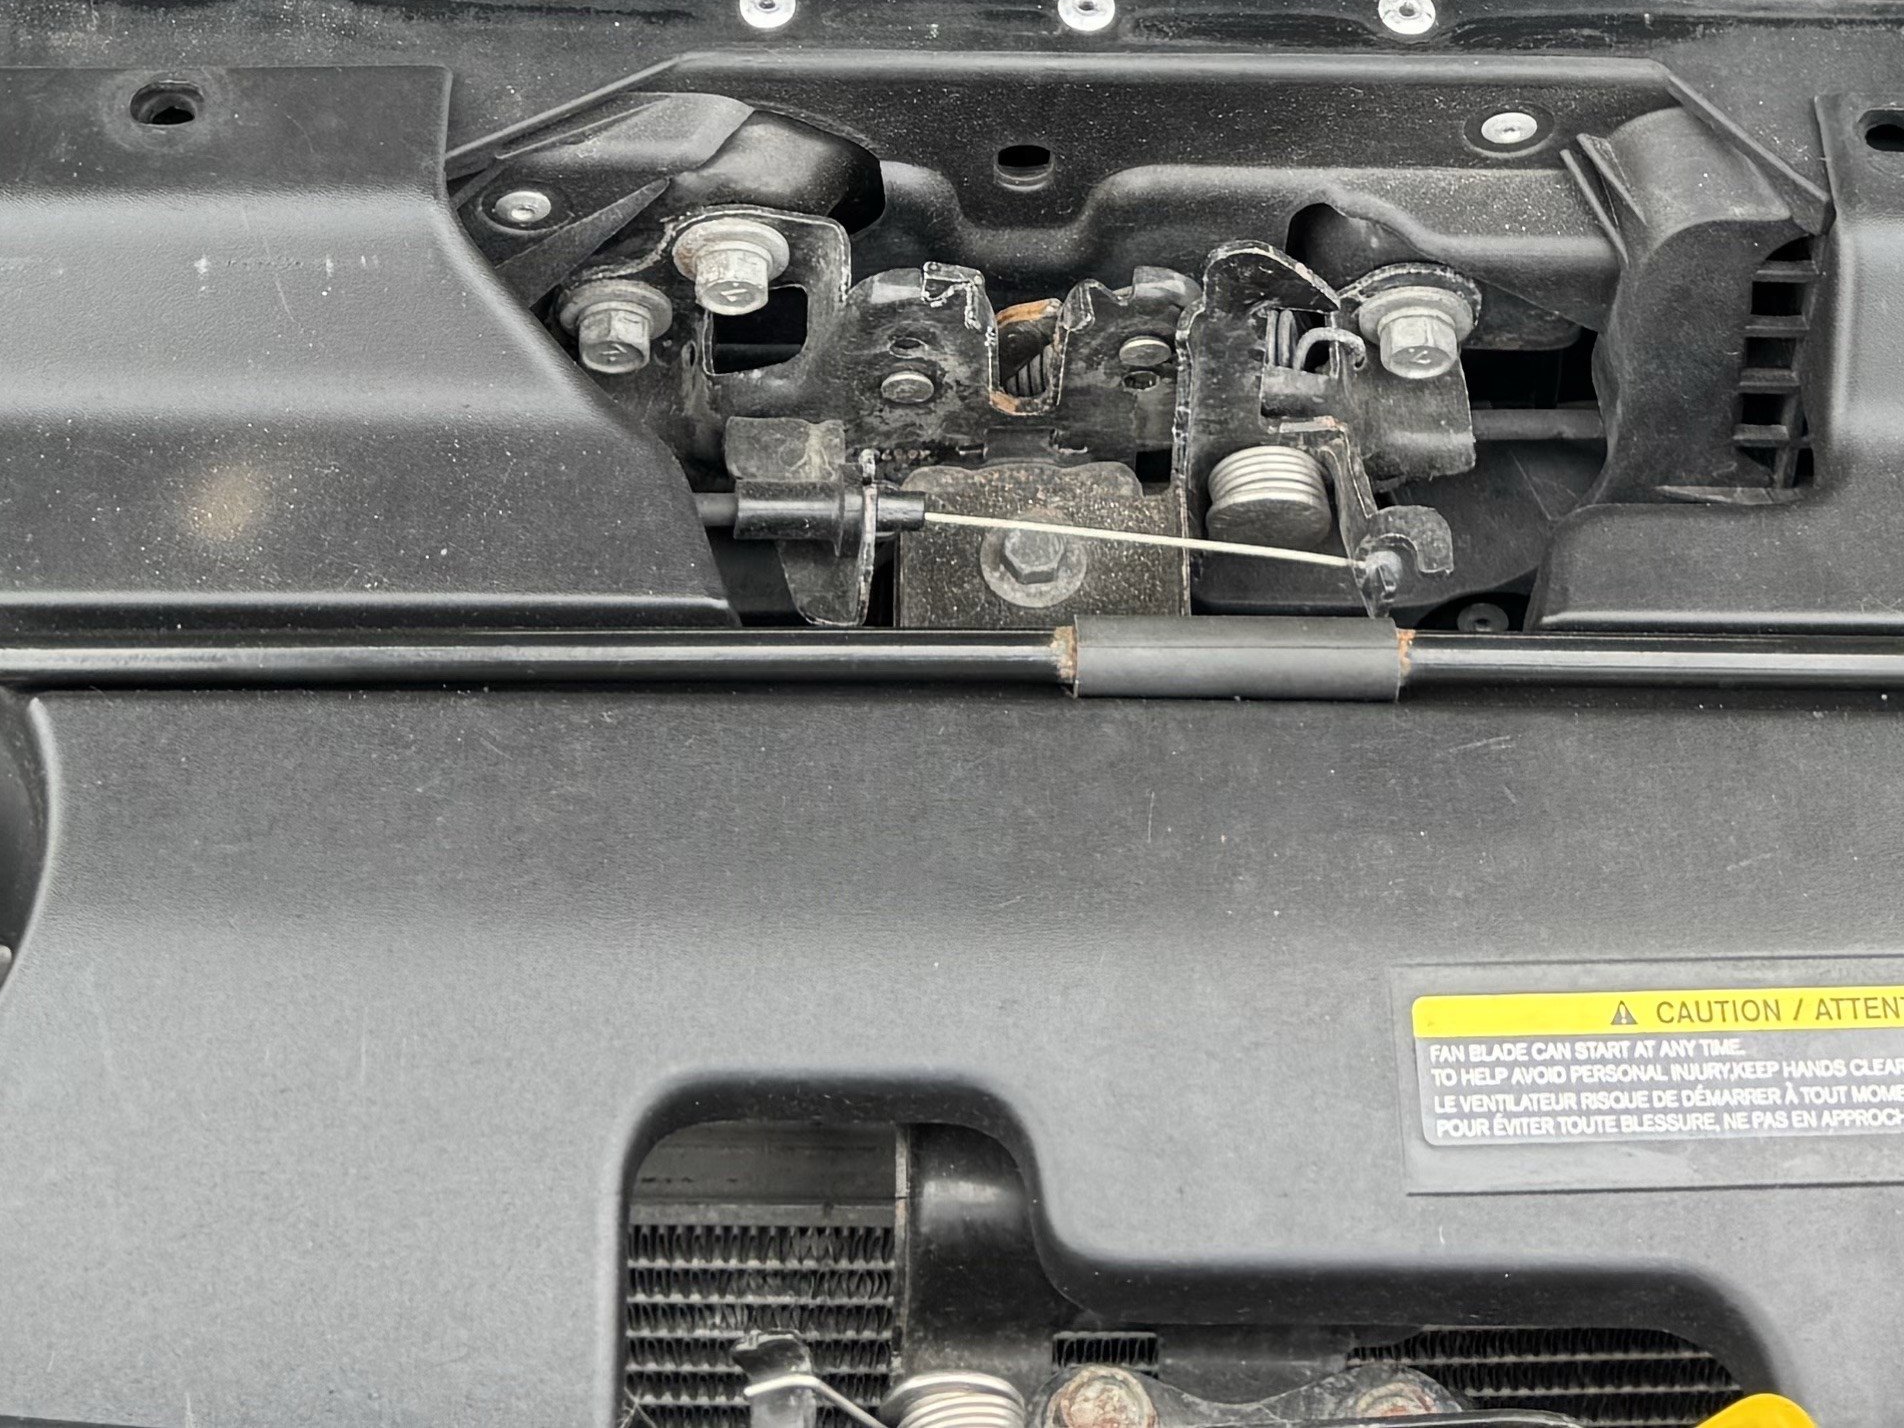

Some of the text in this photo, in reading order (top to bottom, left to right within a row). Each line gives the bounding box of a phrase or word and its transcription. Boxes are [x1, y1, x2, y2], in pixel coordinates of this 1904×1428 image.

[1657, 998, 1781, 1024] CAUTION
[1792, 998, 1804, 1021] /
[1429, 1038, 1746, 1064] FAN BLADE CAN START AT ANY TIME.
[1430, 1067, 1457, 1087] TO
[1460, 1066, 1508, 1086] HELP
[1511, 1064, 1567, 1085] AVOID
[1570, 1063, 1668, 1083] PERSONAL
[1782, 1059, 1847, 1079] HANDS
[1434, 1095, 1457, 1113] LE
[1459, 1093, 1578, 1114] VENTILATEUR
[1580, 1091, 1650, 1111] RISQUE
[1652, 1090, 1679, 1109] DE
[1682, 1083, 1781, 1107] DÉMARRER
[1784, 1081, 1799, 1105] À
[1800, 1086, 1849, 1105] TOUT
[1435, 1117, 1489, 1137] POUR
[1492, 1111, 1554, 1136] ÉVITER
[1556, 1115, 1617, 1134] TOUTE
[1620, 1111, 1720, 1133] BLESSURE,
[1723, 1112, 1749, 1130] NE
[1752, 1110, 1789, 1129] PAS
[1791, 1109, 1818, 1128] EN
